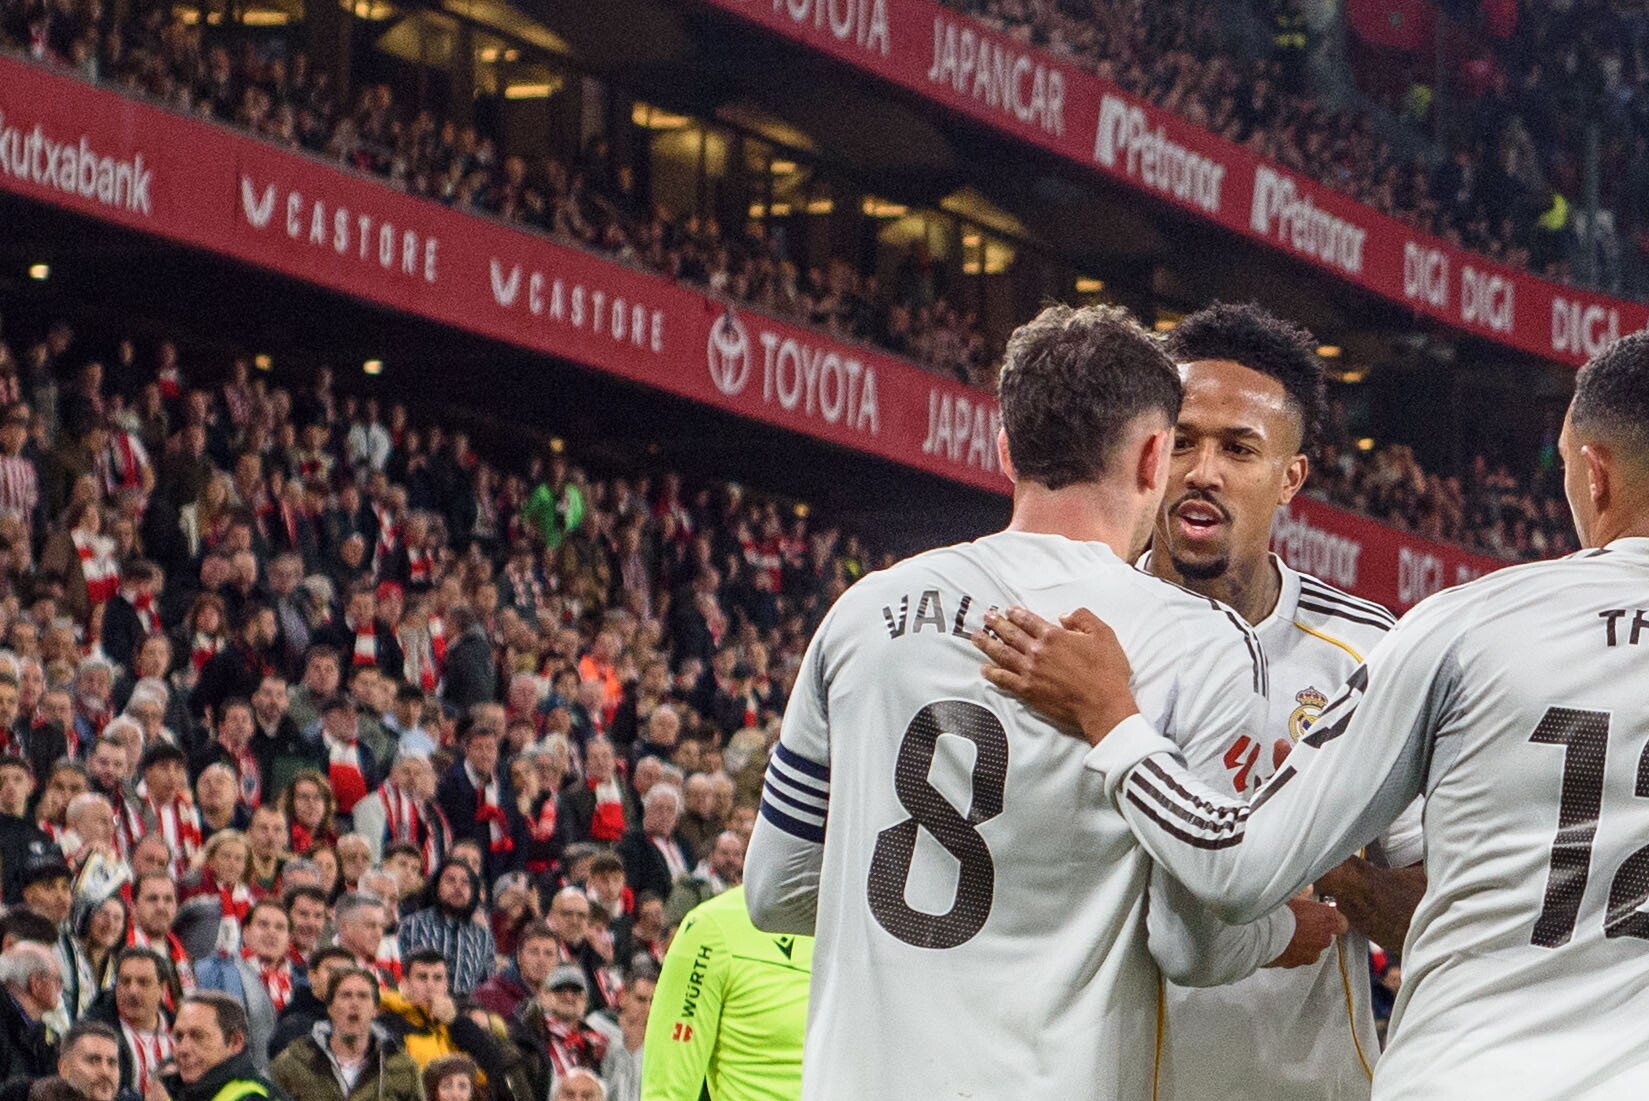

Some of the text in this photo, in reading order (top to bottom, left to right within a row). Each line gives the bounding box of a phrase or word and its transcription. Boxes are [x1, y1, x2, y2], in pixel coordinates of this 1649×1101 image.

[928, 15, 1066, 136] JAPANCAR
[286, 191, 438, 284] CASTORE
[528, 271, 664, 353] CASTORE
[760, 333, 880, 435] TOYOTA
[867, 699, 1009, 950] 8
[682, 944, 713, 1019] WÜRTH
